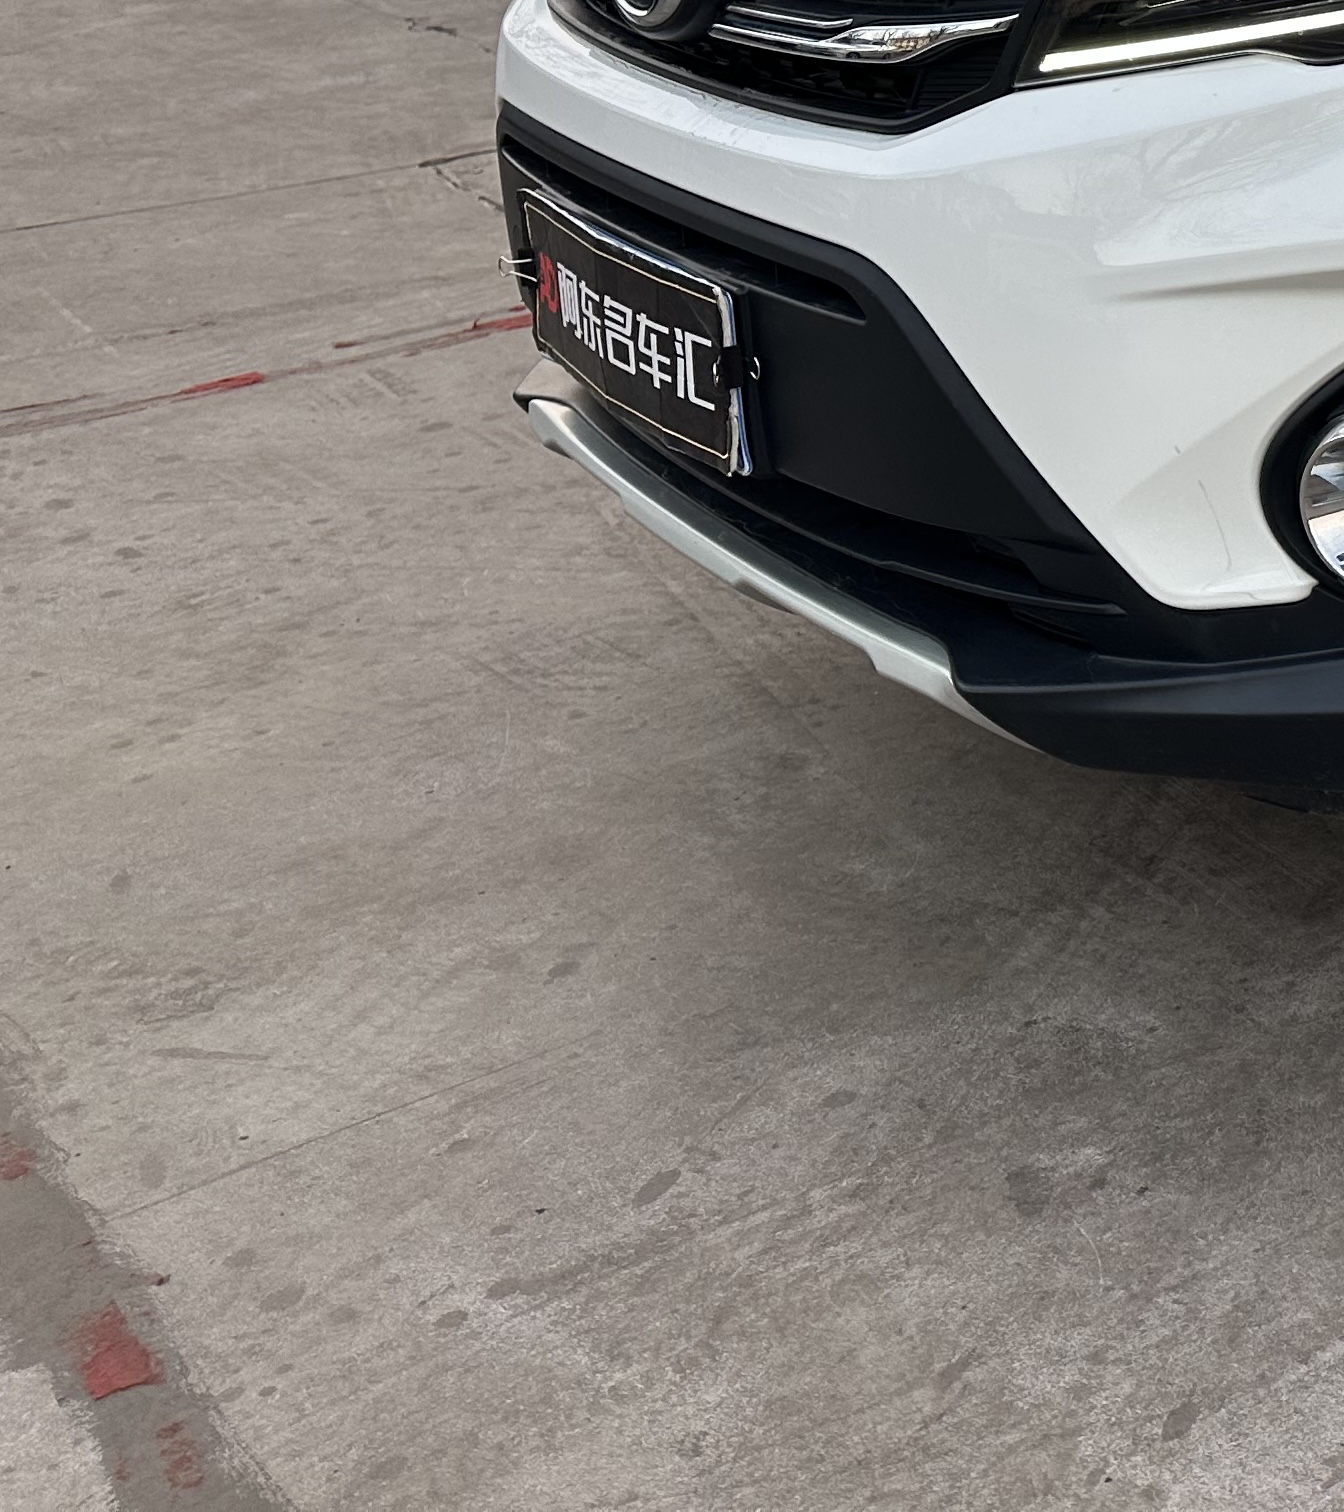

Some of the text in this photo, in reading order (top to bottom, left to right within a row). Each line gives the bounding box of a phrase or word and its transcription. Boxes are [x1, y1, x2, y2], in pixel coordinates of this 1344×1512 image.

[557, 261, 716, 412] 阿东名车汇
